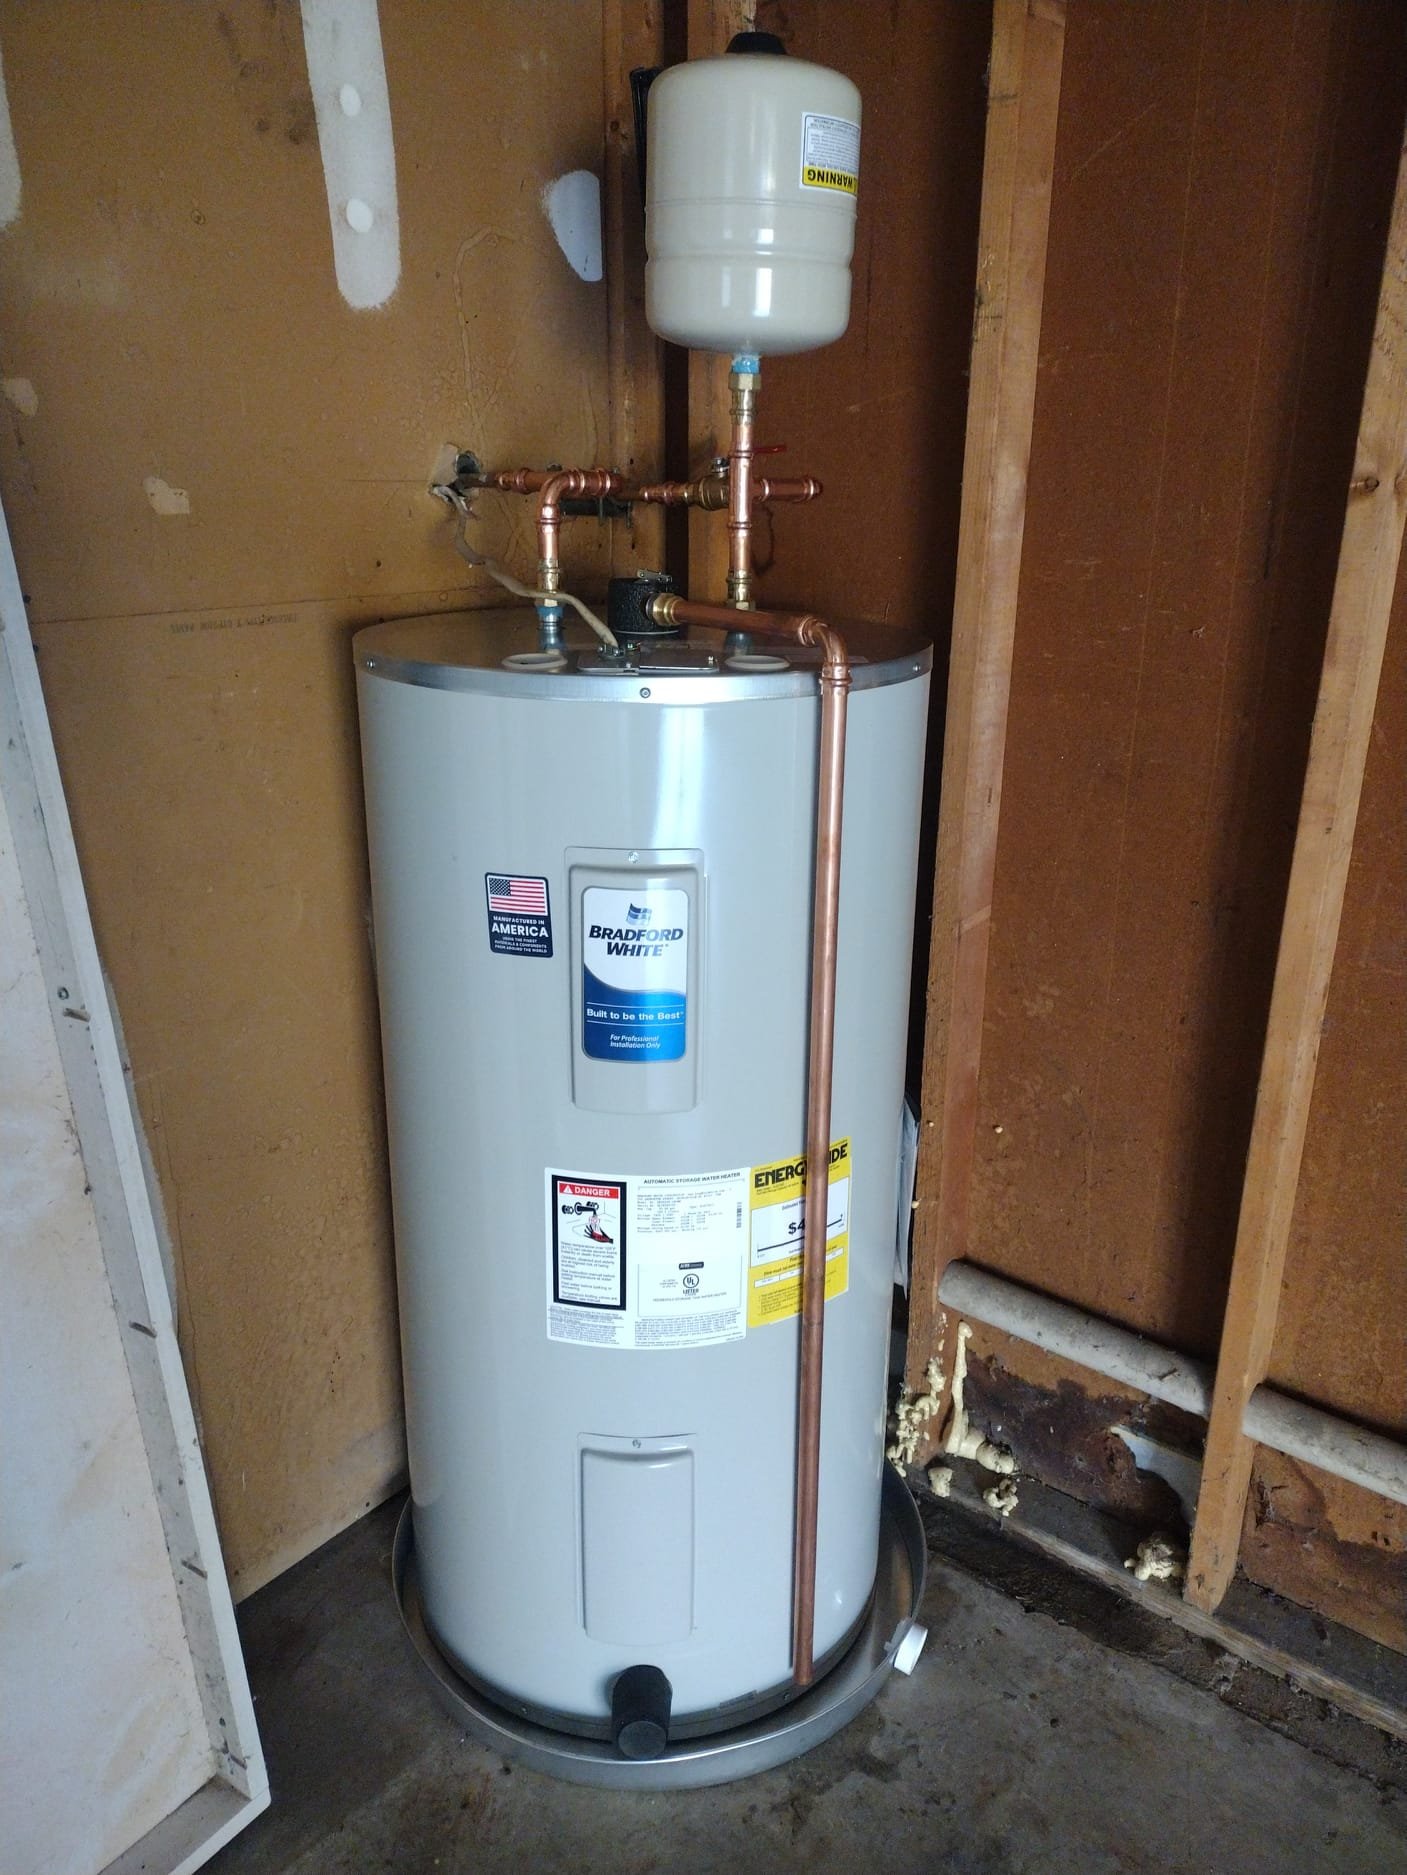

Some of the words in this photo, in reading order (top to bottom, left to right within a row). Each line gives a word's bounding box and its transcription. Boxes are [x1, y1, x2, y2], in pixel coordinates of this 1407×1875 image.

[808, 169, 852, 187] WARNING
[493, 916, 537, 924] MANUFACTURED
[492, 922, 548, 938] AMERICA
[589, 925, 684, 941] BRADFORD
[586, 1008, 608, 1018] Built
[610, 1012, 620, 1020] to
[622, 1012, 635, 1020] be
[639, 1012, 654, 1020] the
[646, 1042, 661, 1050] Only
[574, 1186, 610, 1196] DANGER
